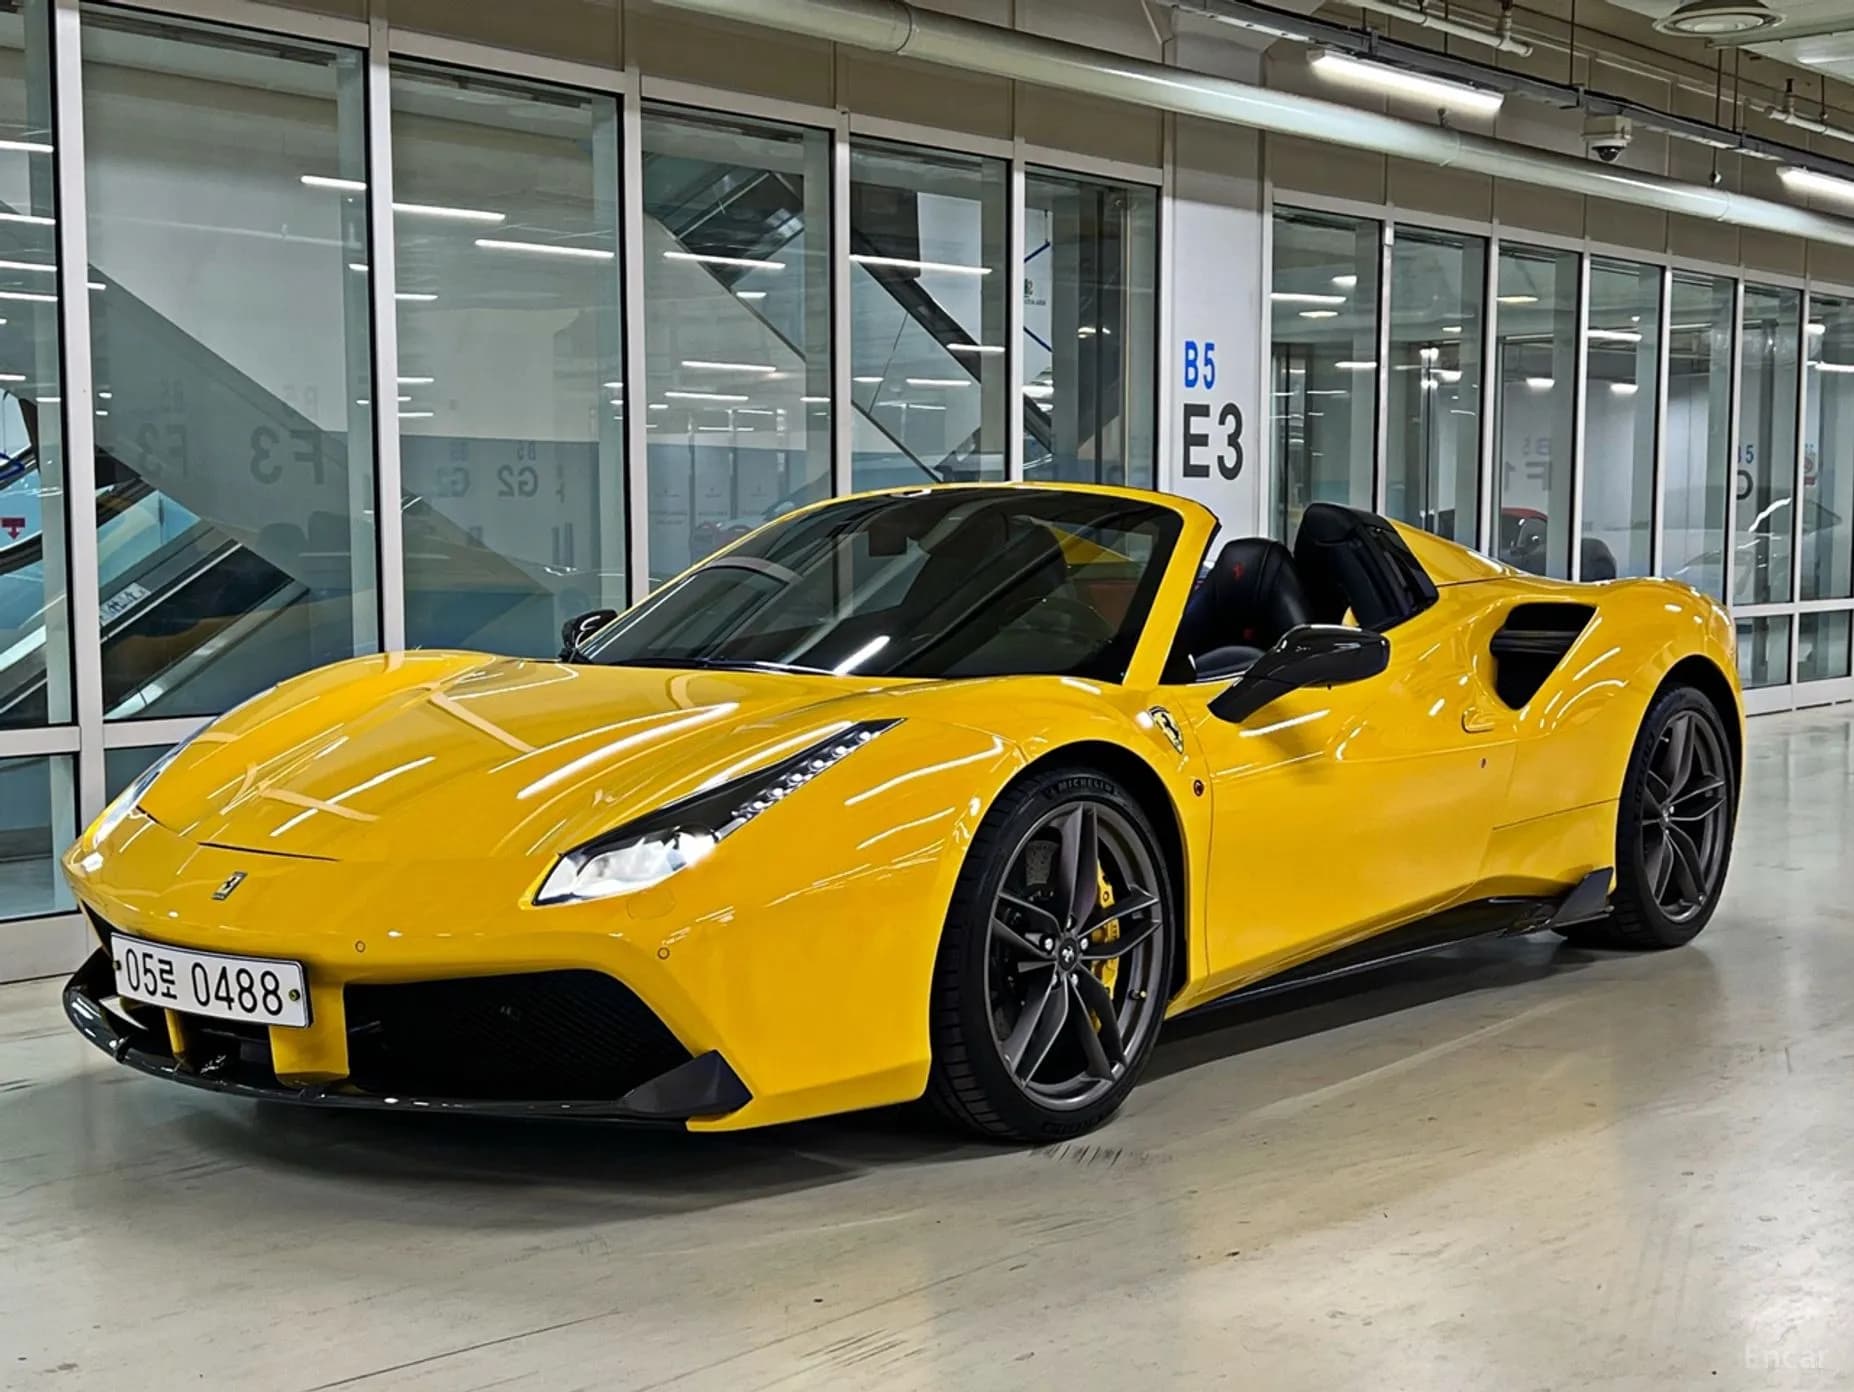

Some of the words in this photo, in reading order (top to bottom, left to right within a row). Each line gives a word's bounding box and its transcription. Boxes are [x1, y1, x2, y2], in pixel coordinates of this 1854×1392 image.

[1184, 340, 1216, 390] B5
[1182, 402, 1244, 480] E3
[1738, 444, 1754, 464] 5
[126, 948, 178, 1001] 05로
[191, 961, 284, 1017] 0488
